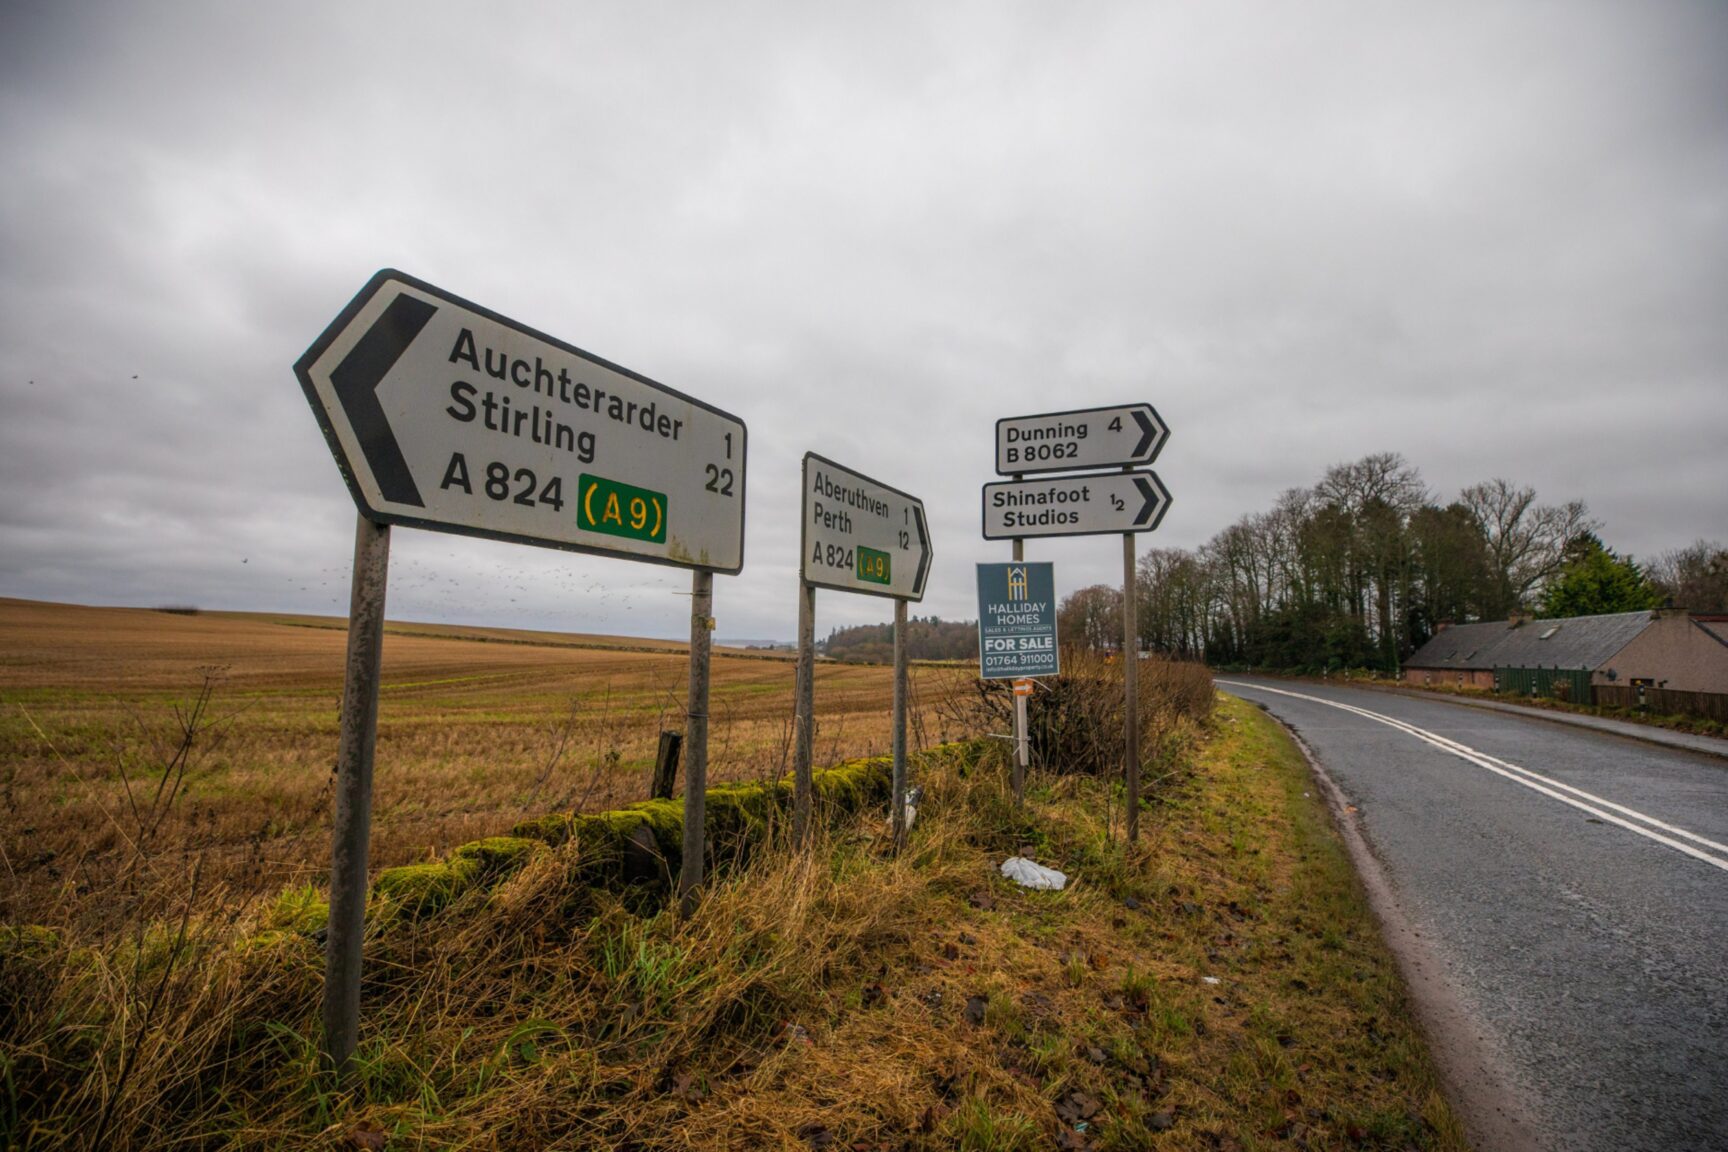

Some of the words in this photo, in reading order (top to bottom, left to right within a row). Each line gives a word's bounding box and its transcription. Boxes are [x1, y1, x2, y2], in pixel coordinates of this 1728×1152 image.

[448, 327, 683, 441] Auchterarder
[724, 432, 732, 460] 1
[446, 380, 596, 464] Stirling
[704, 463, 734, 498] 22
[1007, 422, 1088, 444] Dunning
[1107, 416, 1123, 433] 4
[1024, 442, 1079, 462] 8062
[484, 461, 564, 513] 824
[813, 471, 889, 519] Aberuthven
[904, 507, 908, 525] 1
[992, 485, 1090, 508] Shinafoot
[814, 501, 853, 535] Perth
[898, 529, 909, 551] 12
[1003, 509, 1079, 528] Studios
[988, 602, 1046, 614] HALLIDAY
[997, 614, 1040, 625] HOMES
[985, 639, 1015, 651] FOR
[1019, 637, 1053, 649] SALE
[985, 655, 1017, 666] 01764
[1020, 654, 1053, 664] 911000
